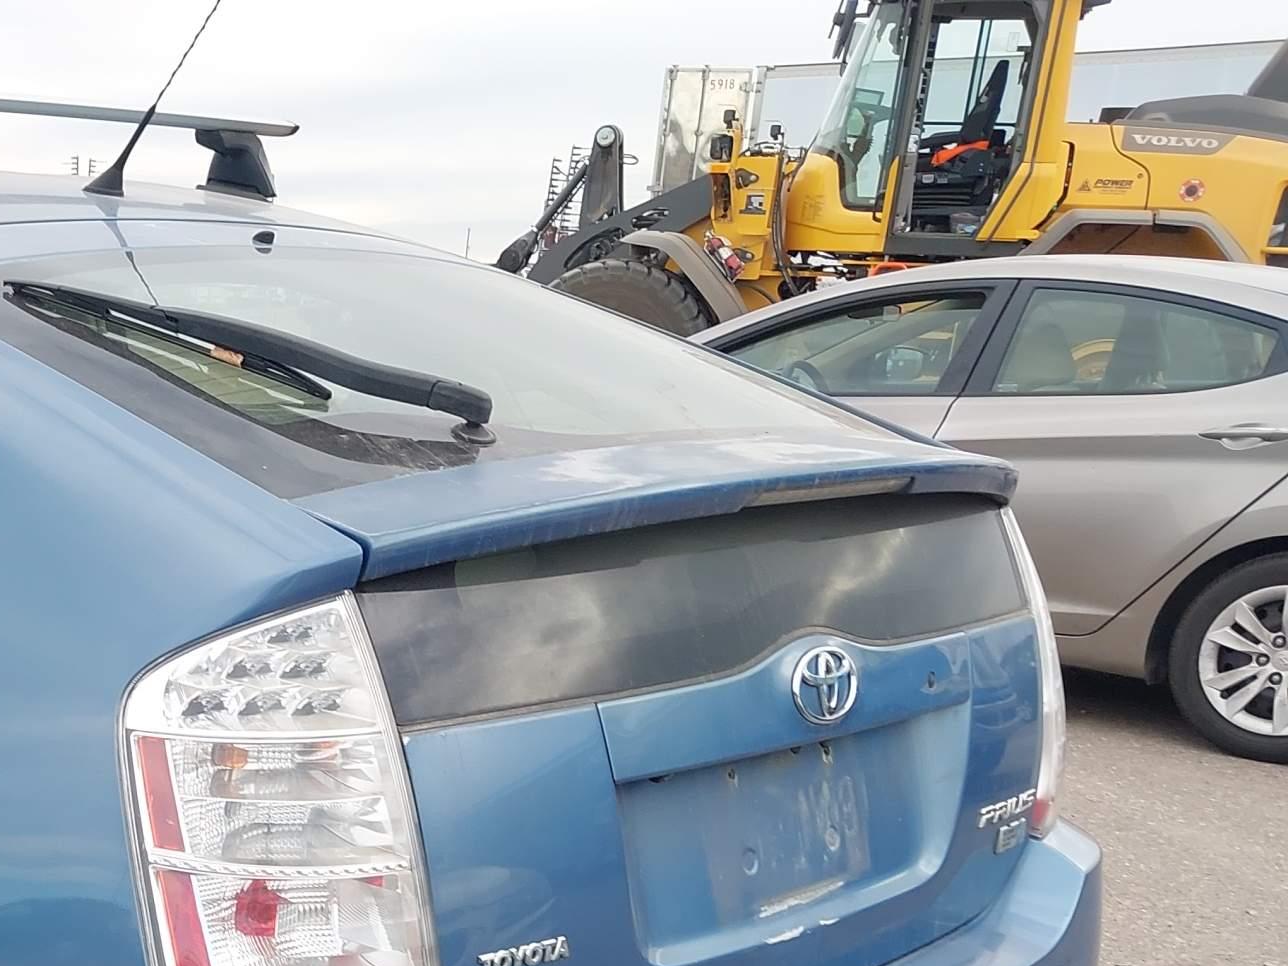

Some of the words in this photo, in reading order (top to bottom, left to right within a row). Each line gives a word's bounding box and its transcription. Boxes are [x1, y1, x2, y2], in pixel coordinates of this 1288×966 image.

[710, 79, 735, 90] 5918
[1132, 134, 1219, 149] VOLVO
[977, 788, 1037, 829] PRIUS
